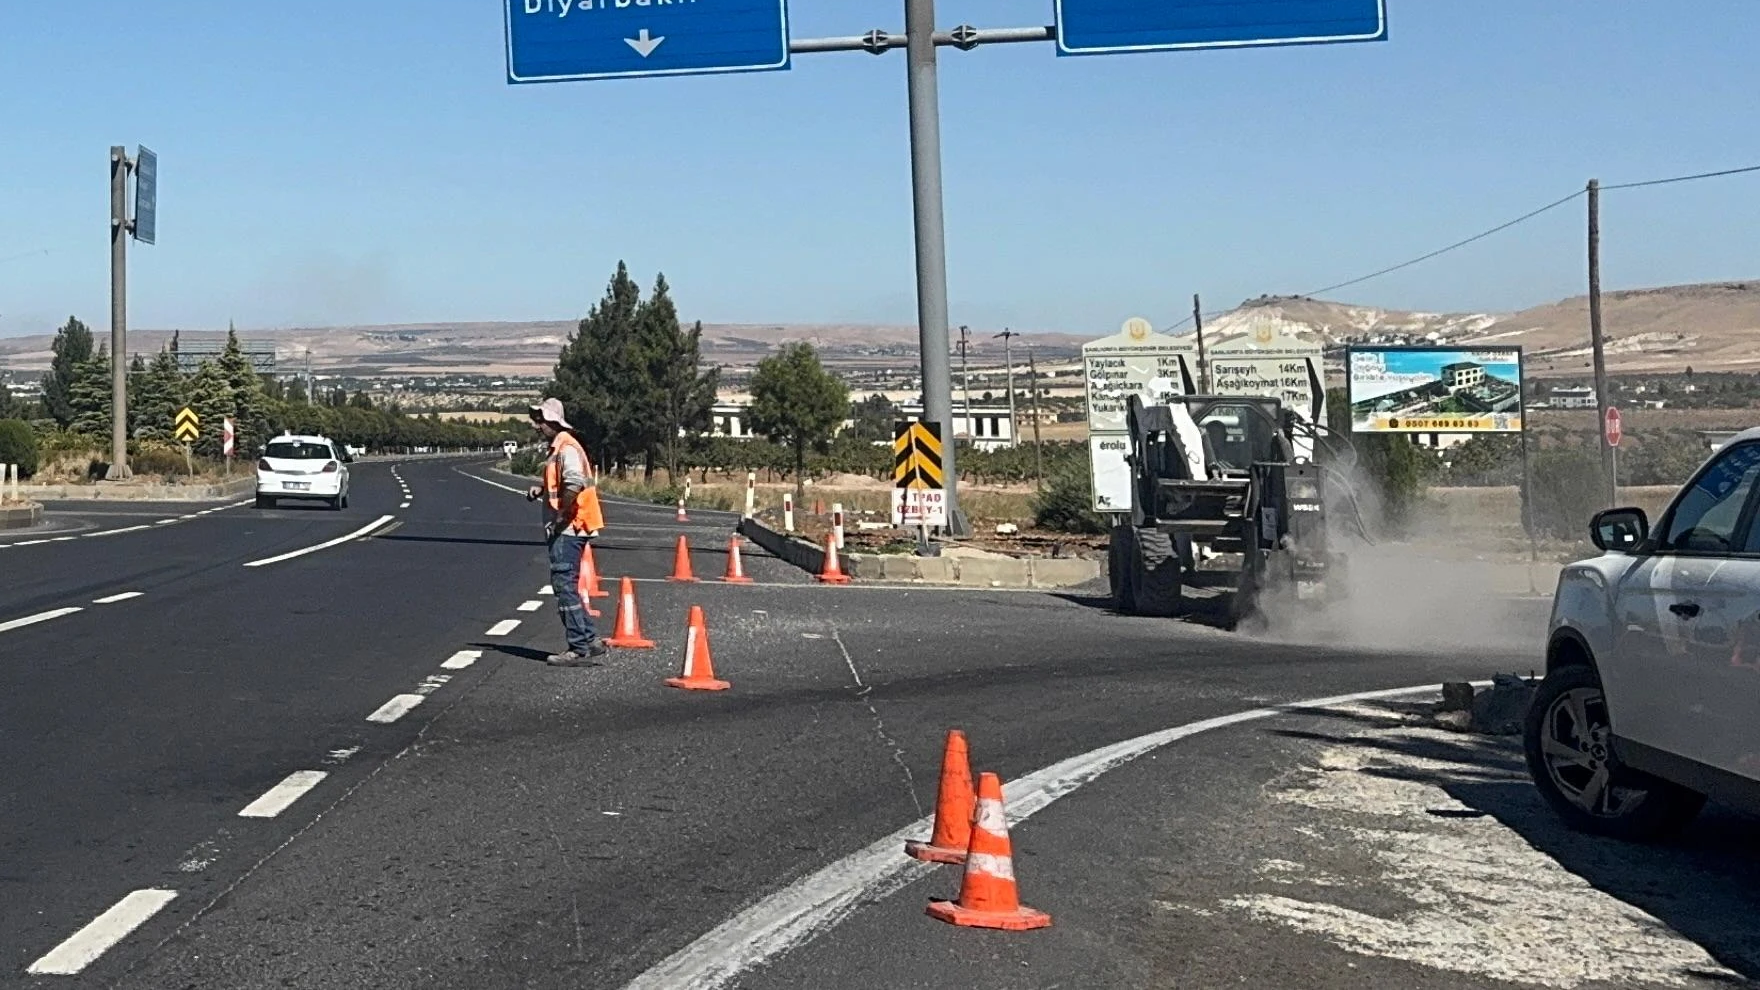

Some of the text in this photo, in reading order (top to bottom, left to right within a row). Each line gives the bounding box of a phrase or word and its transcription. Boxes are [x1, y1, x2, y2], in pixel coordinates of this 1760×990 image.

[1157, 358, 1177, 367] 1Km
[1278, 363, 1306, 373] 14Km
[1280, 392, 1308, 401] 17Km
